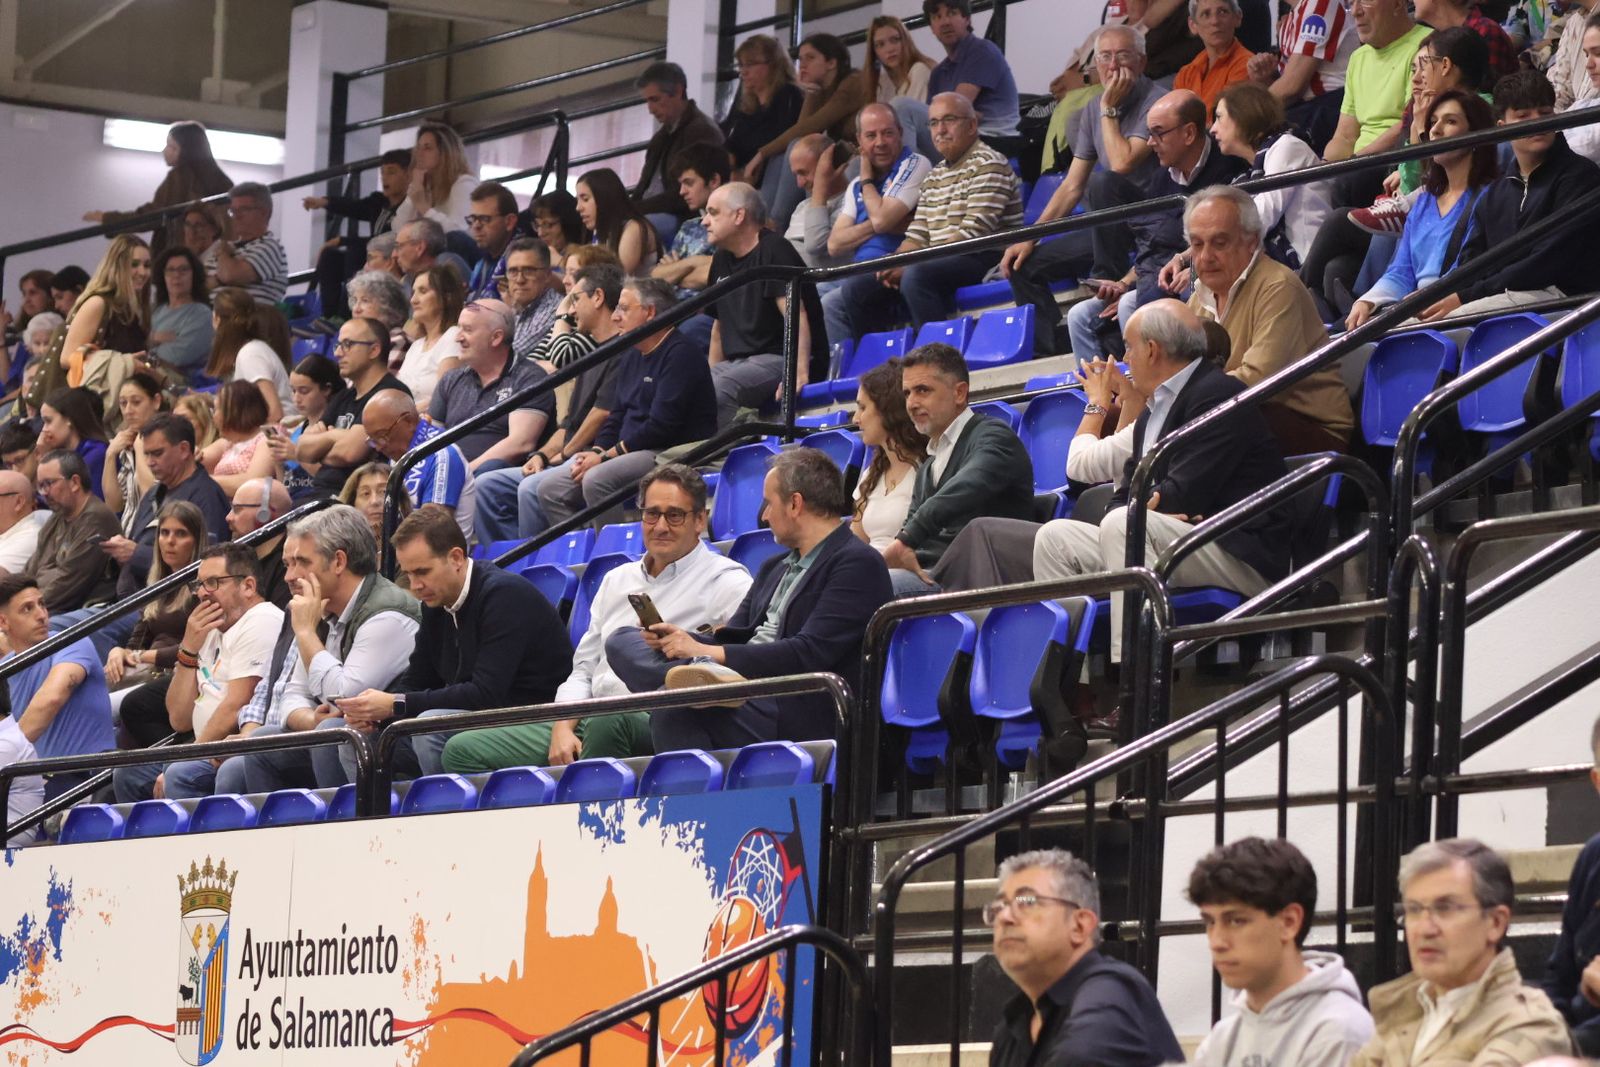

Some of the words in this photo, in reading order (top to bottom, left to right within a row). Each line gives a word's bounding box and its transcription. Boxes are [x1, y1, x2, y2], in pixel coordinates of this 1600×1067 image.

[239, 923, 398, 991] Ayuntamiento
[236, 998, 261, 1050] de
[269, 996, 394, 1049] Salamanca
